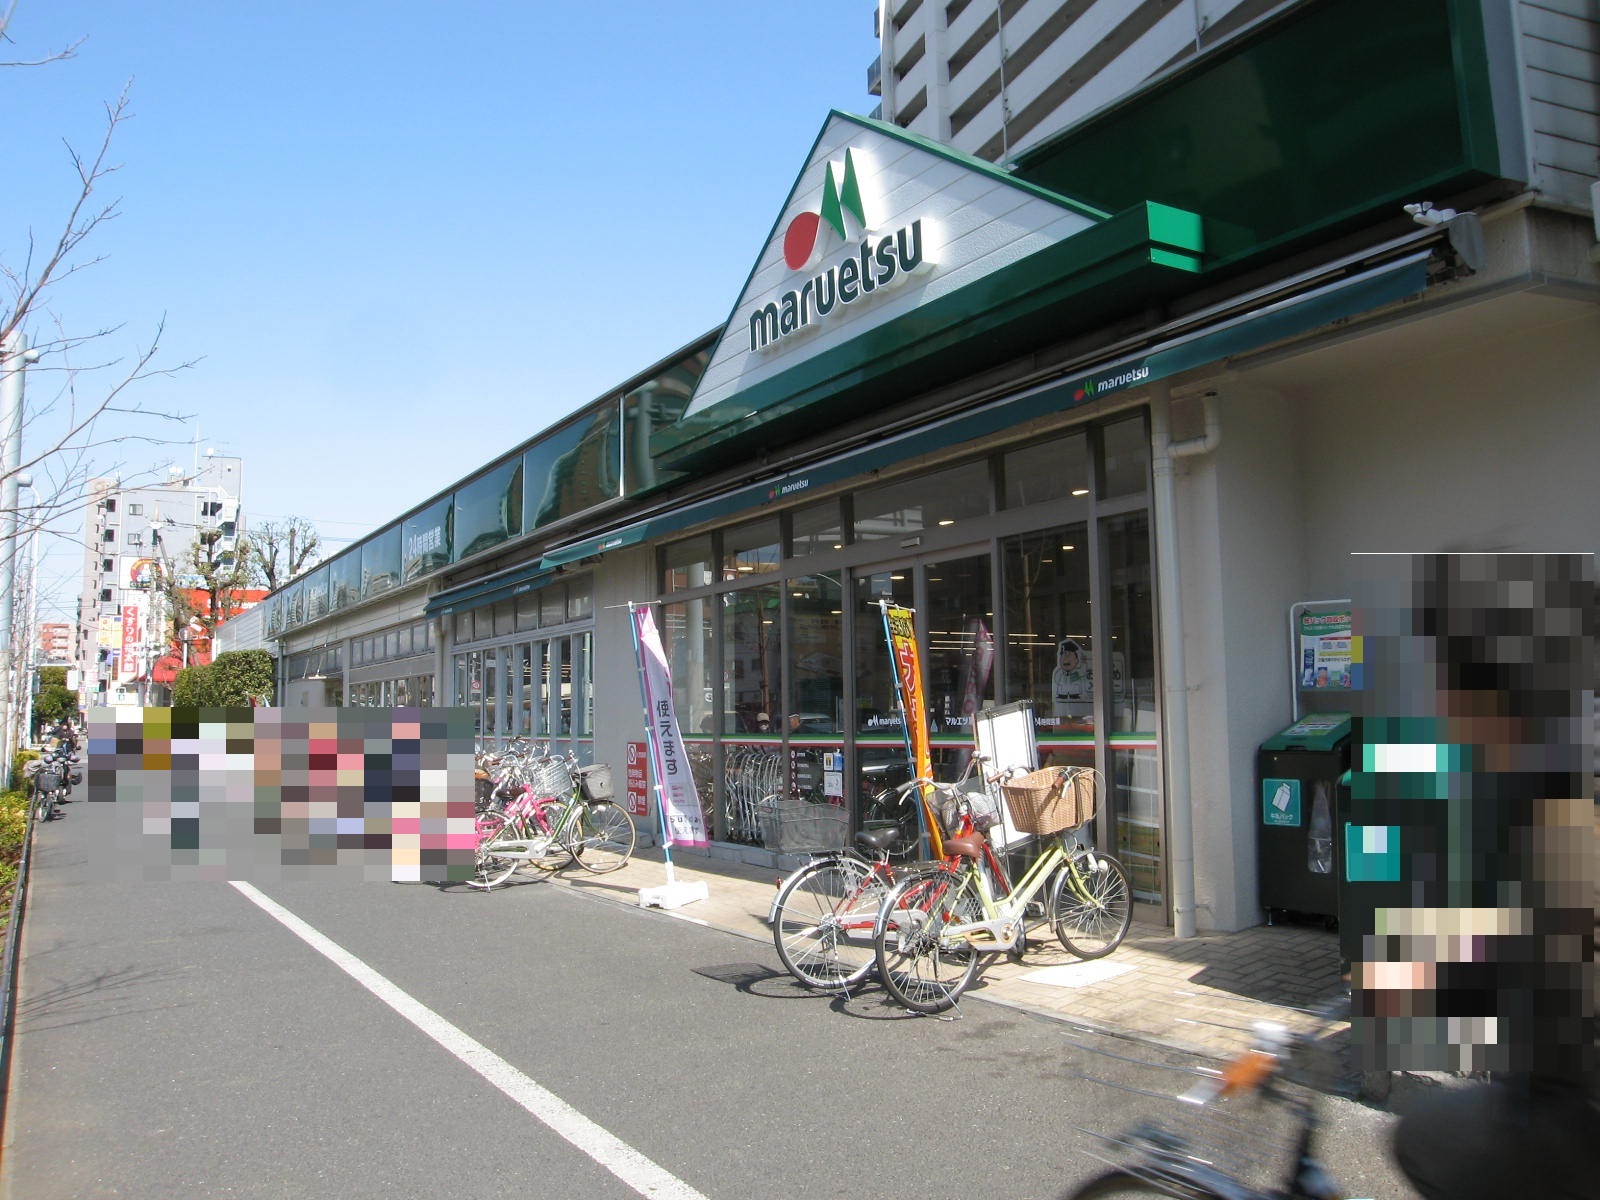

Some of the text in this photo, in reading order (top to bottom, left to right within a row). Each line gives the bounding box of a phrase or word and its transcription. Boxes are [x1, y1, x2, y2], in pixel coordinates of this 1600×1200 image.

[750, 218, 923, 352] maruetsu
[1098, 366, 1149, 393] maruetsu
[781, 478, 809, 495] maruetsu
[656, 699, 678, 776] 使えます
